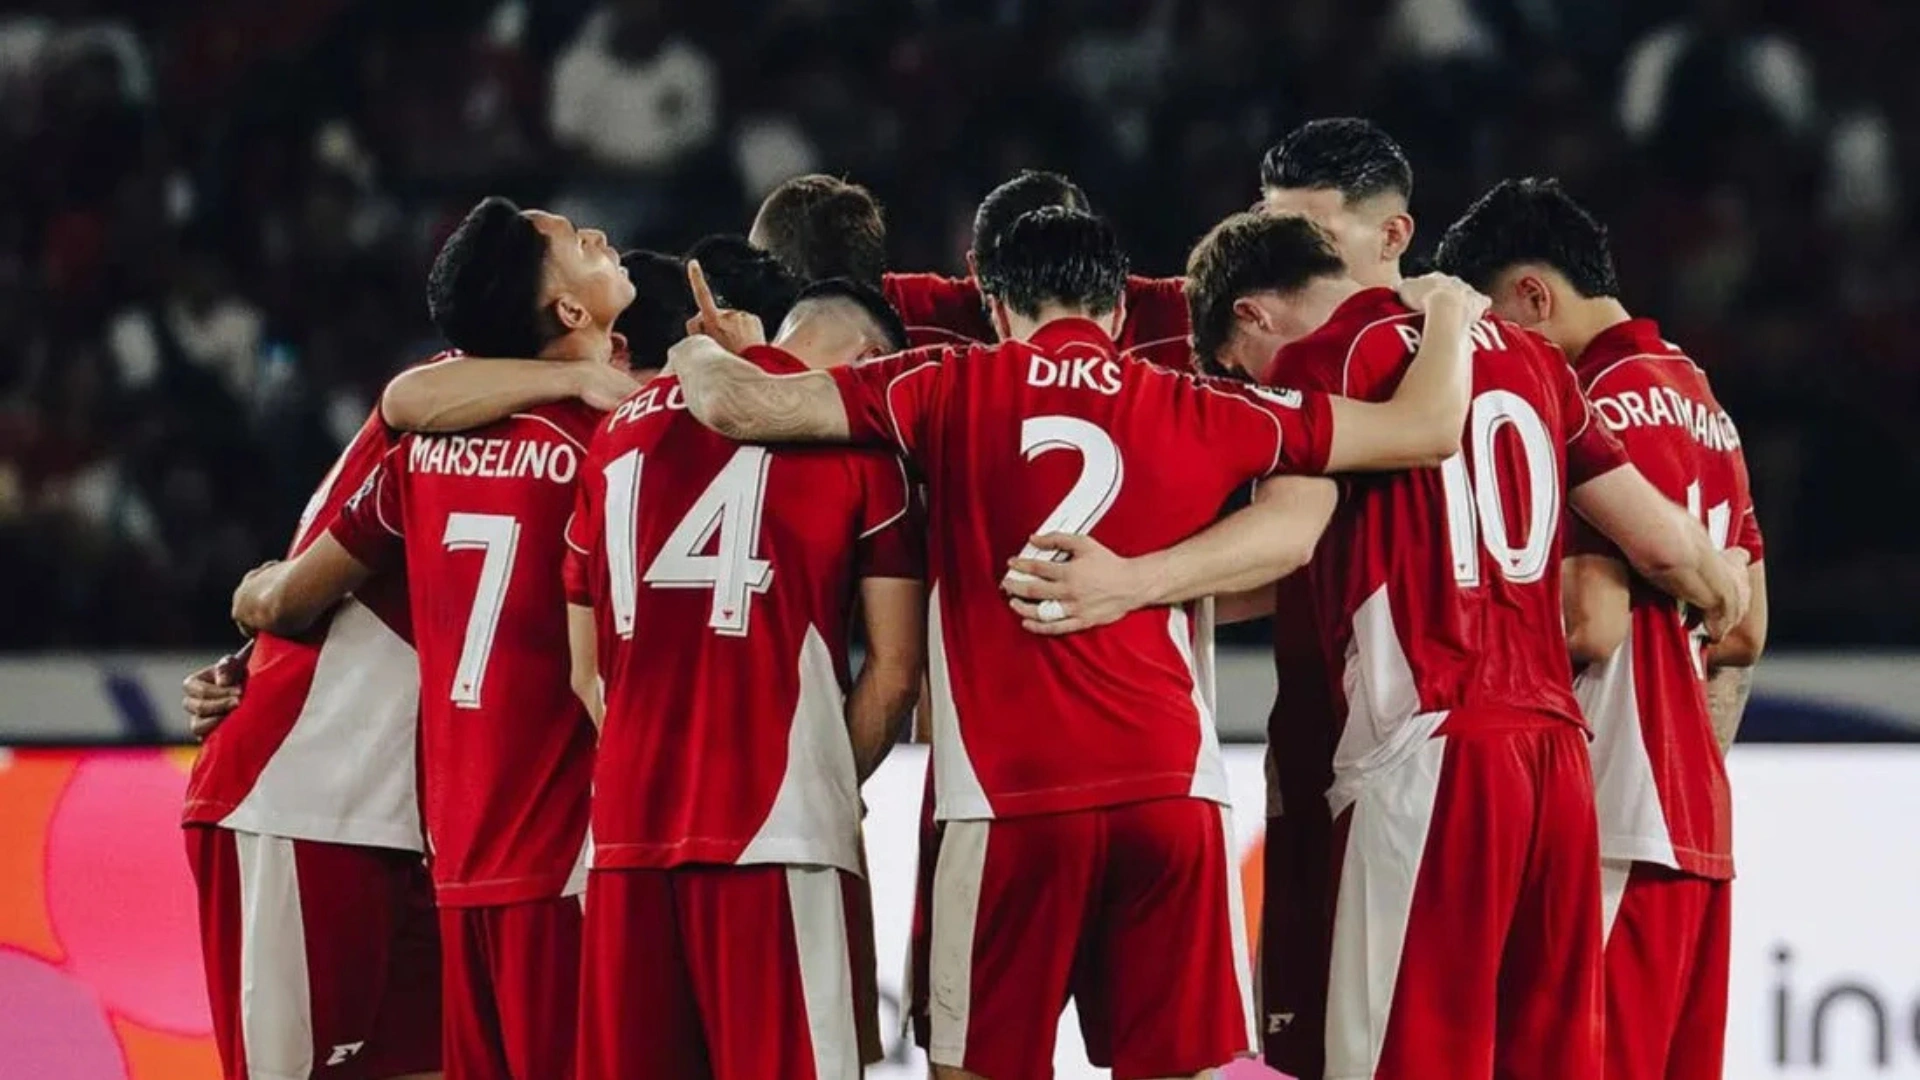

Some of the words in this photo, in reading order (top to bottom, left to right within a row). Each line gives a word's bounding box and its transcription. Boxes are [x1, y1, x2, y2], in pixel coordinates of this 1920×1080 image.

[408, 434, 577, 484] MARSELINO
[1027, 354, 1122, 395] DIKS
[602, 446, 775, 640] 14
[1003, 414, 1125, 584] 2
[1441, 389, 1561, 588] 10
[442, 512, 522, 709] 7
[1771, 942, 1920, 1069] in
